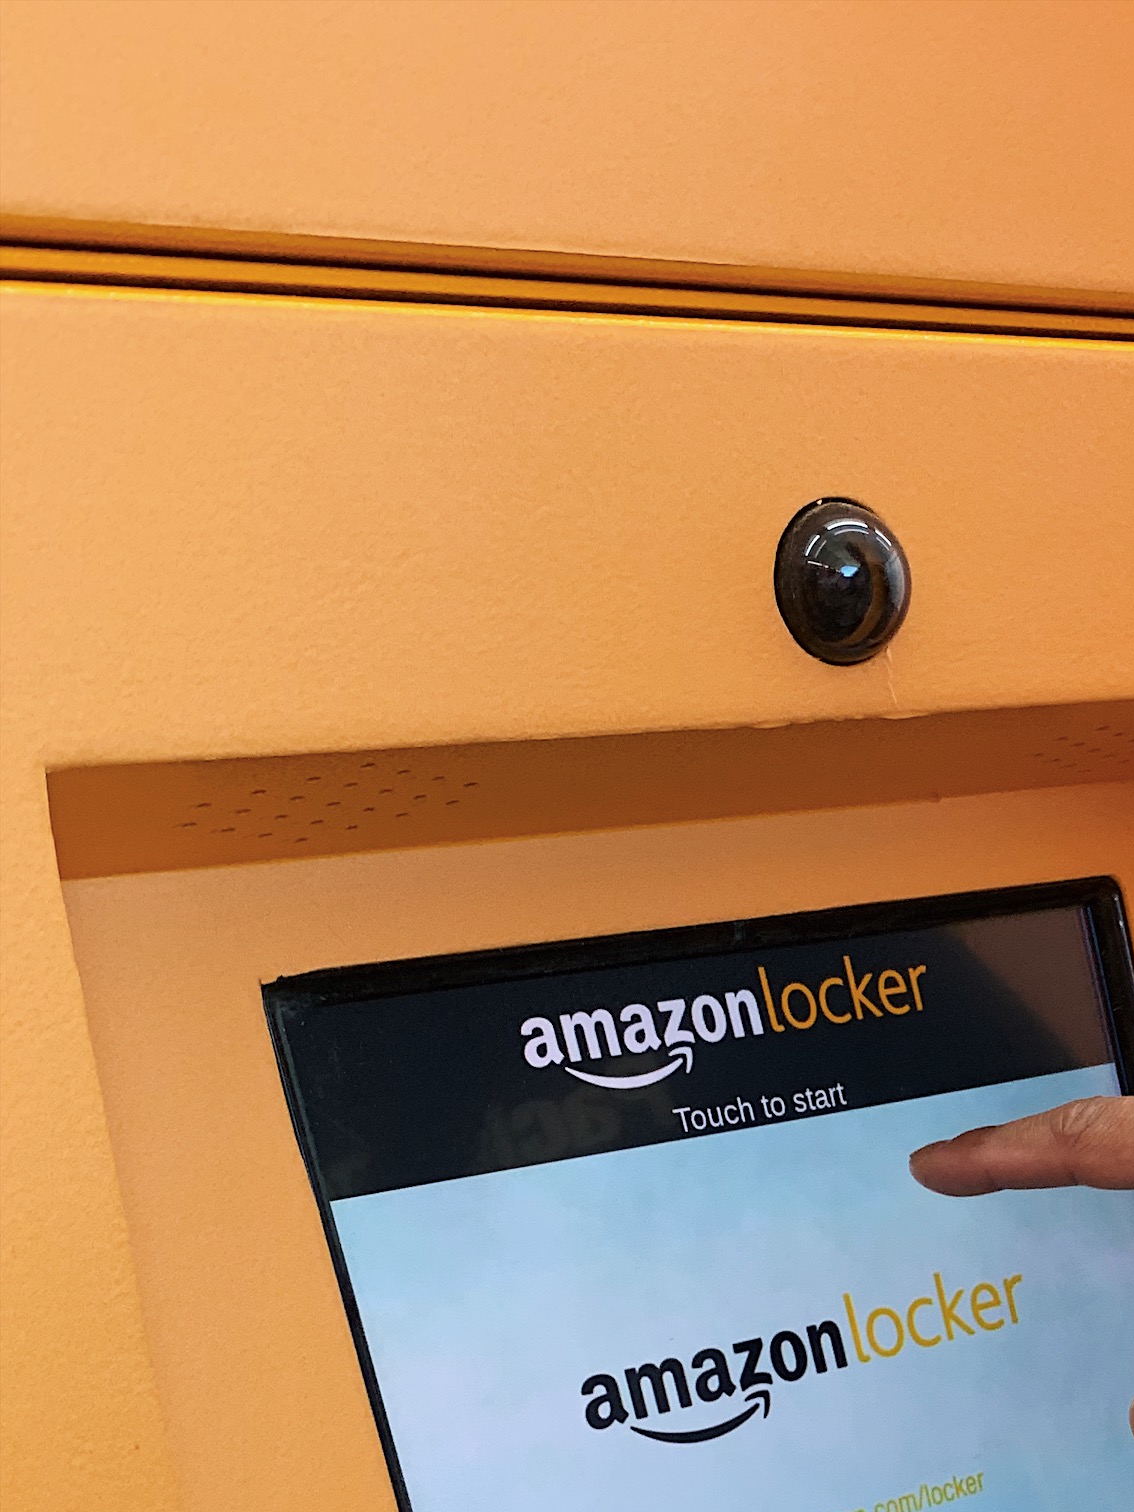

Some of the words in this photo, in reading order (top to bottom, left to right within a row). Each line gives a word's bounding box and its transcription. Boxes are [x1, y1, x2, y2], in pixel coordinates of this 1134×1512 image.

[520, 955, 927, 1068] amazonlocker
[671, 1095, 756, 1134] Touch
[762, 1094, 786, 1118] to
[792, 1082, 848, 1113] start
[580, 1271, 1023, 1431] amazonlocker
